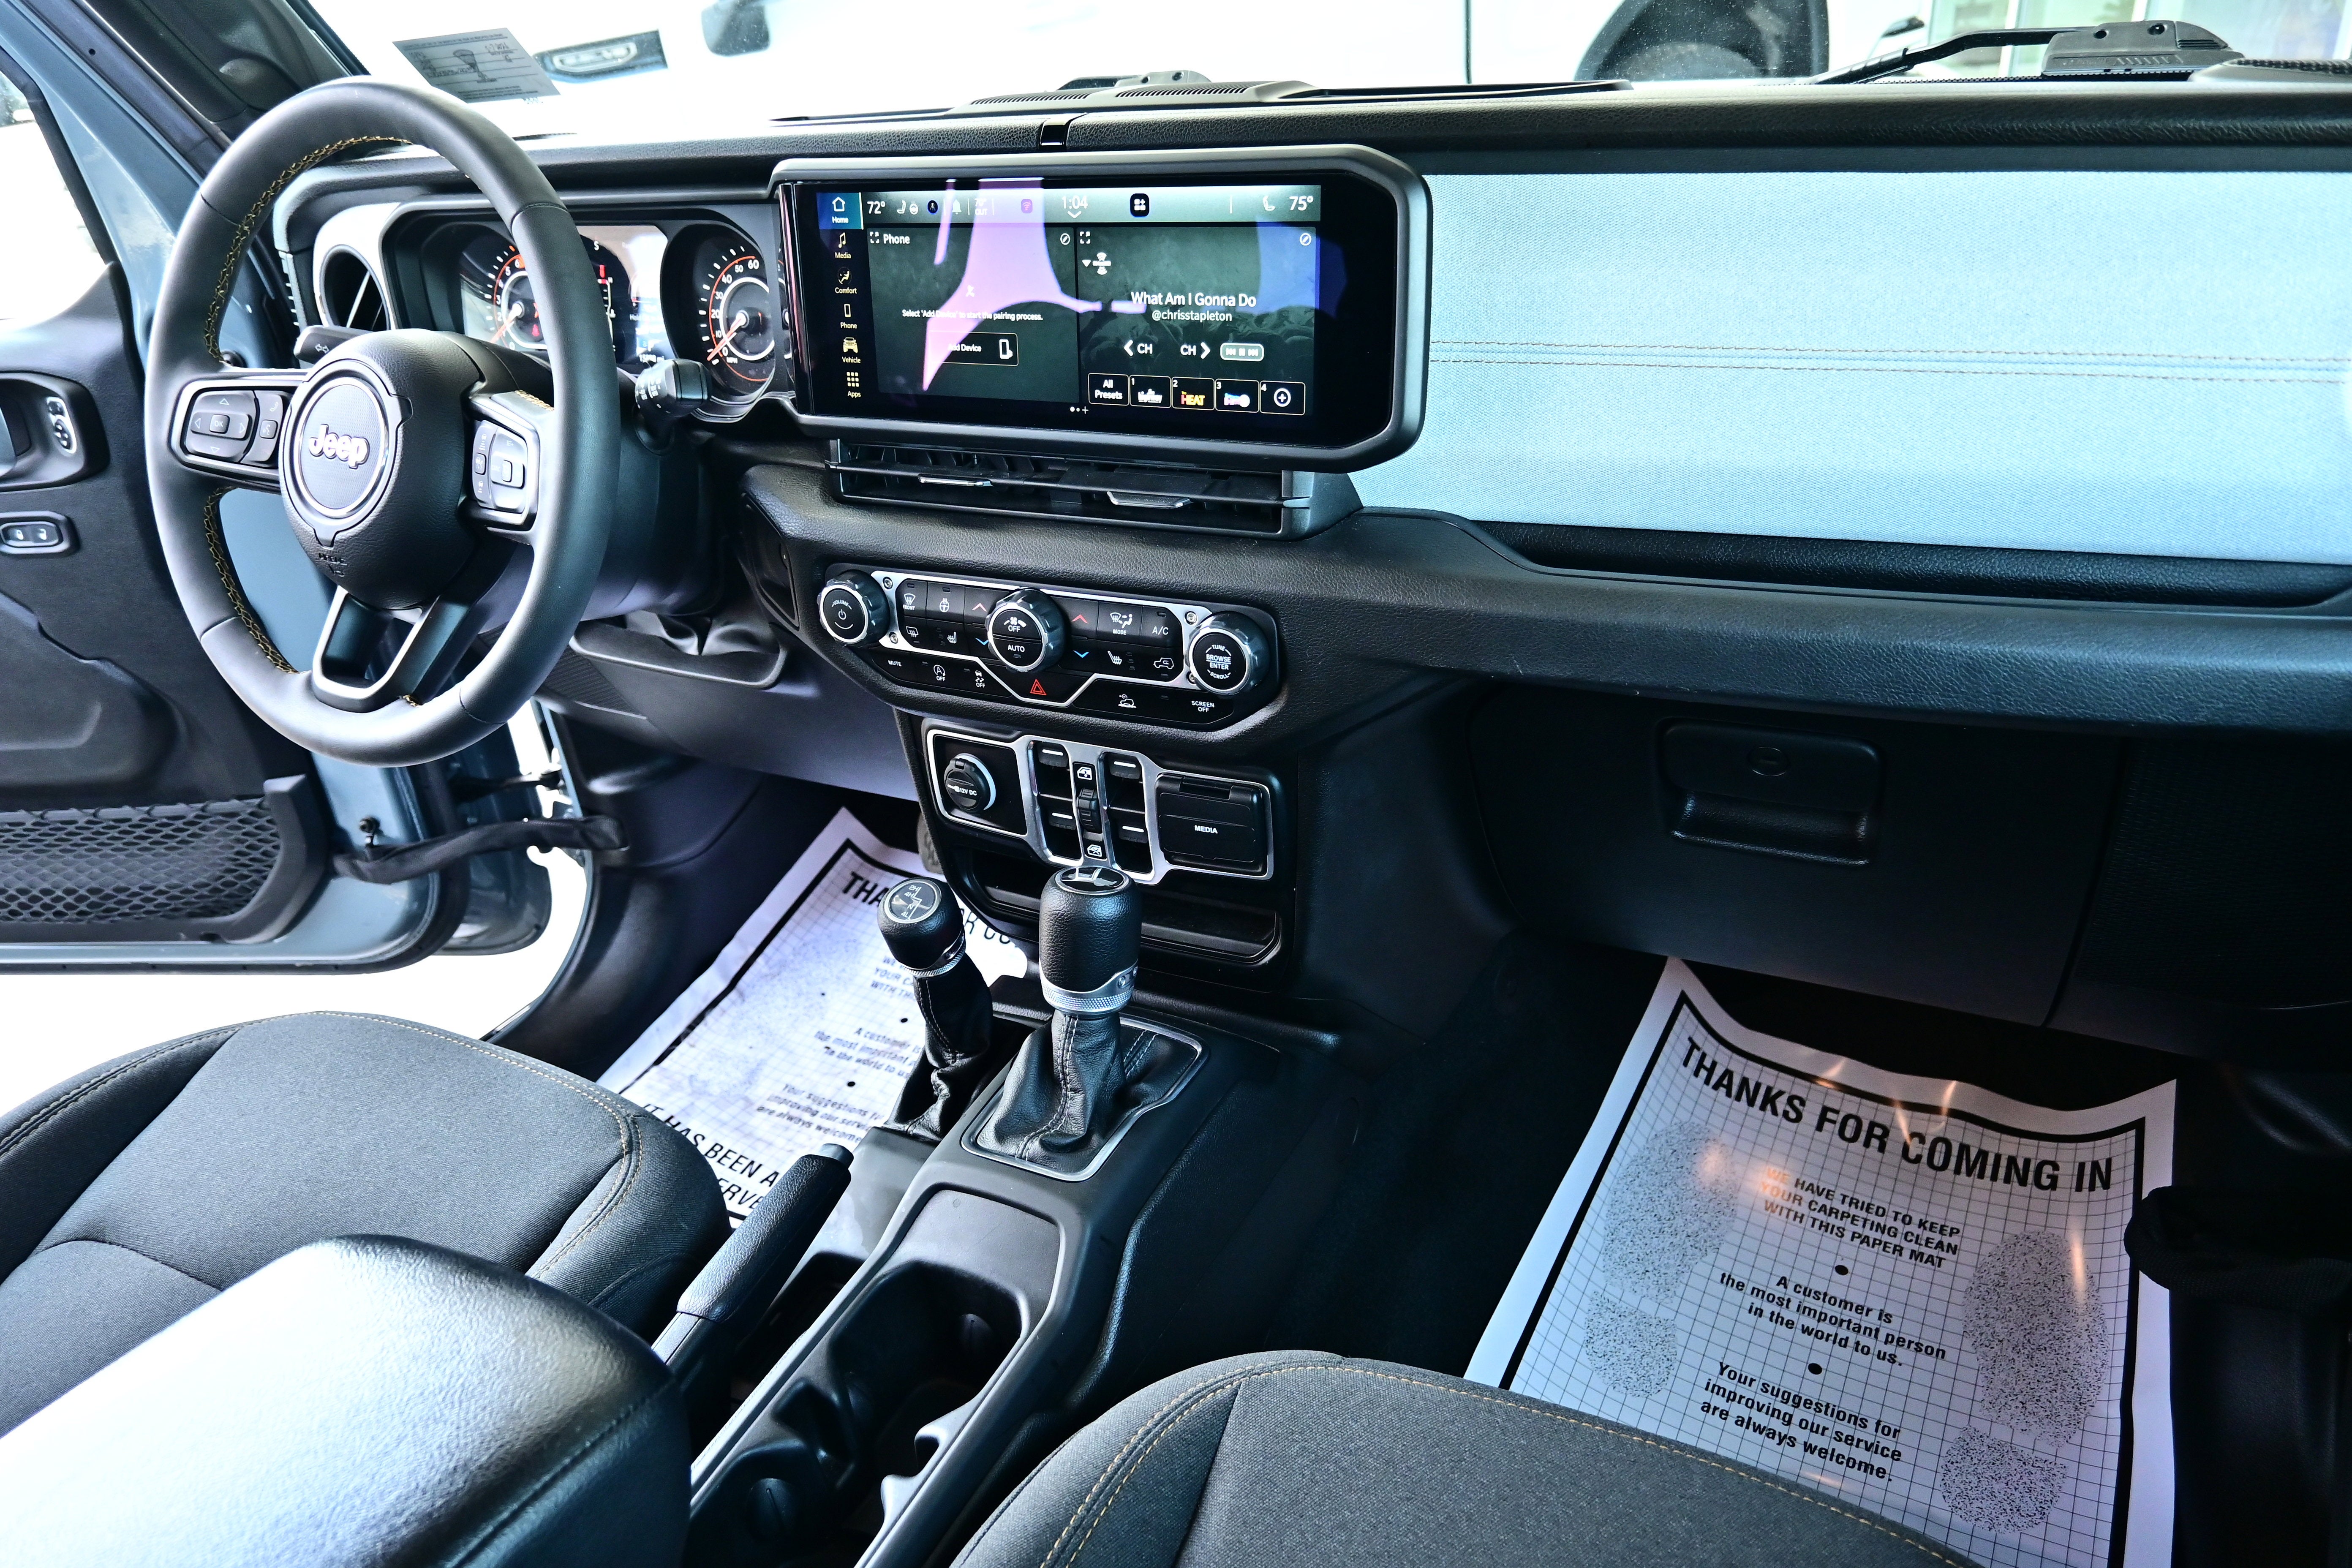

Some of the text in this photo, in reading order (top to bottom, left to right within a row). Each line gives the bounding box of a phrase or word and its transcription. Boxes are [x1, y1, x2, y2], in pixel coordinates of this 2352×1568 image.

[1062, 196, 1088, 210] 1:04
[1289, 196, 1314, 211] 75°
[883, 234, 910, 244] Phone
[735, 264, 744, 273] 50
[748, 259, 760, 270] 60
[505, 266, 511, 276] 5
[721, 274, 732, 284] 40
[715, 291, 724, 300] 30
[835, 286, 857, 294] Comfort
[496, 295, 501, 305] 3
[1131, 291, 1257, 307] What Am I Gonna Do
[711, 309, 720, 319] 20
[902, 309, 920, 317] Select
[994, 312, 1015, 321] pairing
[1016, 313, 1043, 321] process.
[1152, 310, 1232, 323] @chrisstapleton
[716, 330, 722, 338] 10
[509, 341, 515, 351] 0
[722, 346, 728, 357] 0
[948, 343, 982, 352] Add Device
[1137, 343, 1153, 354] CH
[1180, 345, 1196, 356] CH
[1102, 379, 1113, 388] All
[1217, 381, 1222, 389] 3
[1261, 384, 1266, 392] 4
[847, 390, 861, 398] Apps
[1095, 390, 1123, 400] Presets
[1181, 394, 1205, 406] HEAT
[309, 423, 370, 469] Jeep
[833, 599, 849, 607] VOLUME
[1152, 626, 1169, 636] A/C
[1007, 644, 1025, 653] AUTO
[1206, 653, 1231, 663] BROWSE
[1209, 662, 1229, 670] ENTER
[1191, 700, 1215, 708] SCREEN
[1194, 825, 1218, 834] MEDIA
[843, 871, 889, 907] THA
[874, 967, 901, 982] YOUR
[870, 980, 896, 994] WITH
[885, 1064, 896, 1073] to
[1682, 1037, 2112, 1192] THANKS FOR COMING IN
[642, 1104, 664, 1114] IT
[704, 1143, 763, 1179] BEEN
[760, 1171, 779, 1187] A
[718, 1178, 765, 1209] ERVE
[1767, 1168, 1960, 1238] WE HAVE TRIED TO KEEP
[1761, 1183, 1958, 1255] YOUR CARPETING CLEAN
[1764, 1199, 1946, 1269] WITH THIS PAPER MAT
[1776, 1276, 1894, 1324] A customer is
[1720, 1272, 1946, 1360] the most important person
[1748, 1302, 1903, 1367] in the world to us.
[1718, 1361, 1901, 1440] Your suggestions for
[1704, 1378, 1902, 1462] improving our service
[1700, 1401, 1892, 1482] are always welcome.
